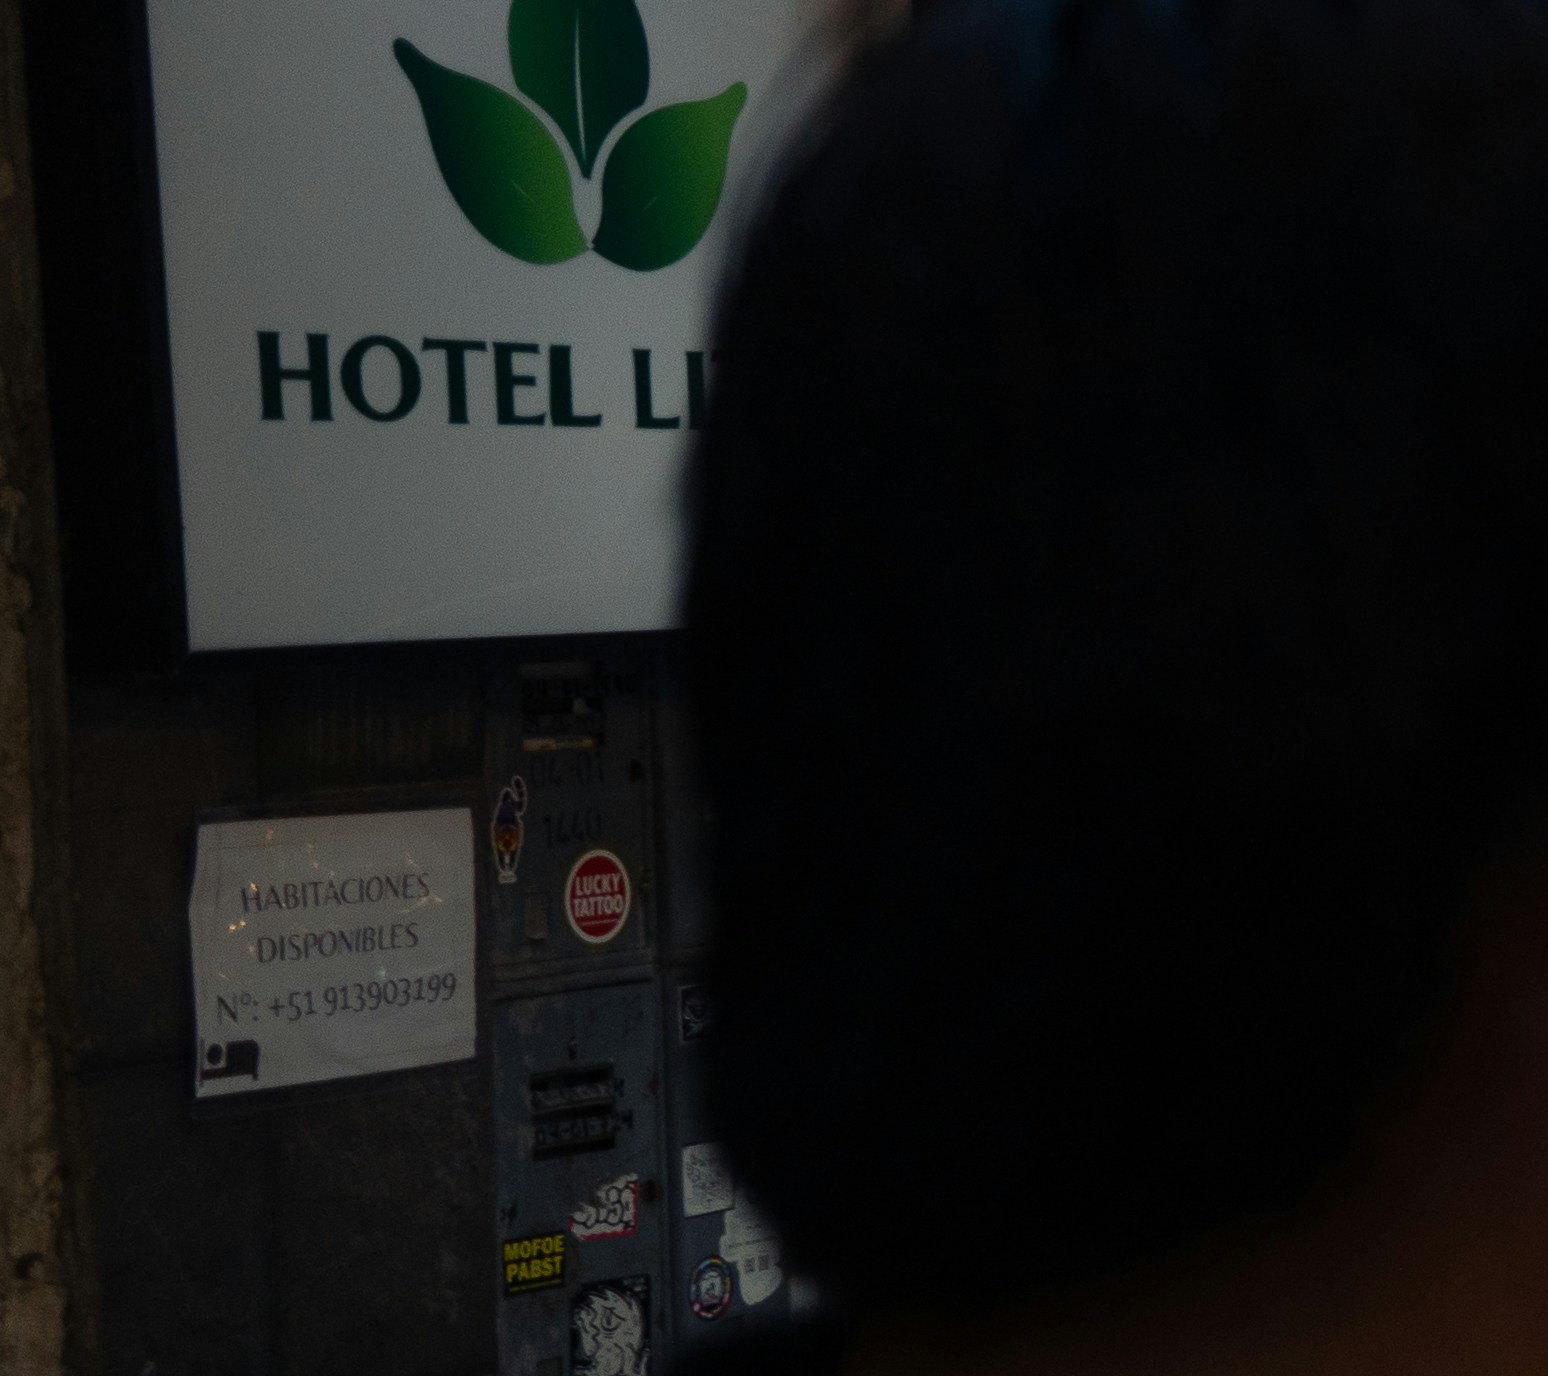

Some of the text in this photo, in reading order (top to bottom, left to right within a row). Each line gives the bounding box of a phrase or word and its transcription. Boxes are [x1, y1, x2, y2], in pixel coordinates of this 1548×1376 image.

[255, 330, 722, 430] HOTEL LI
[240, 871, 431, 914] HABITACIONES
[574, 873, 622, 896] LUCKY
[573, 893, 625, 919] TATTOO
[256, 922, 420, 964] DISPONIBLES
[270, 990, 317, 1022] +51
[322, 972, 458, 1016] 913903199
[503, 1234, 566, 1262] MOFOE
[505, 1256, 565, 1285] PABST
